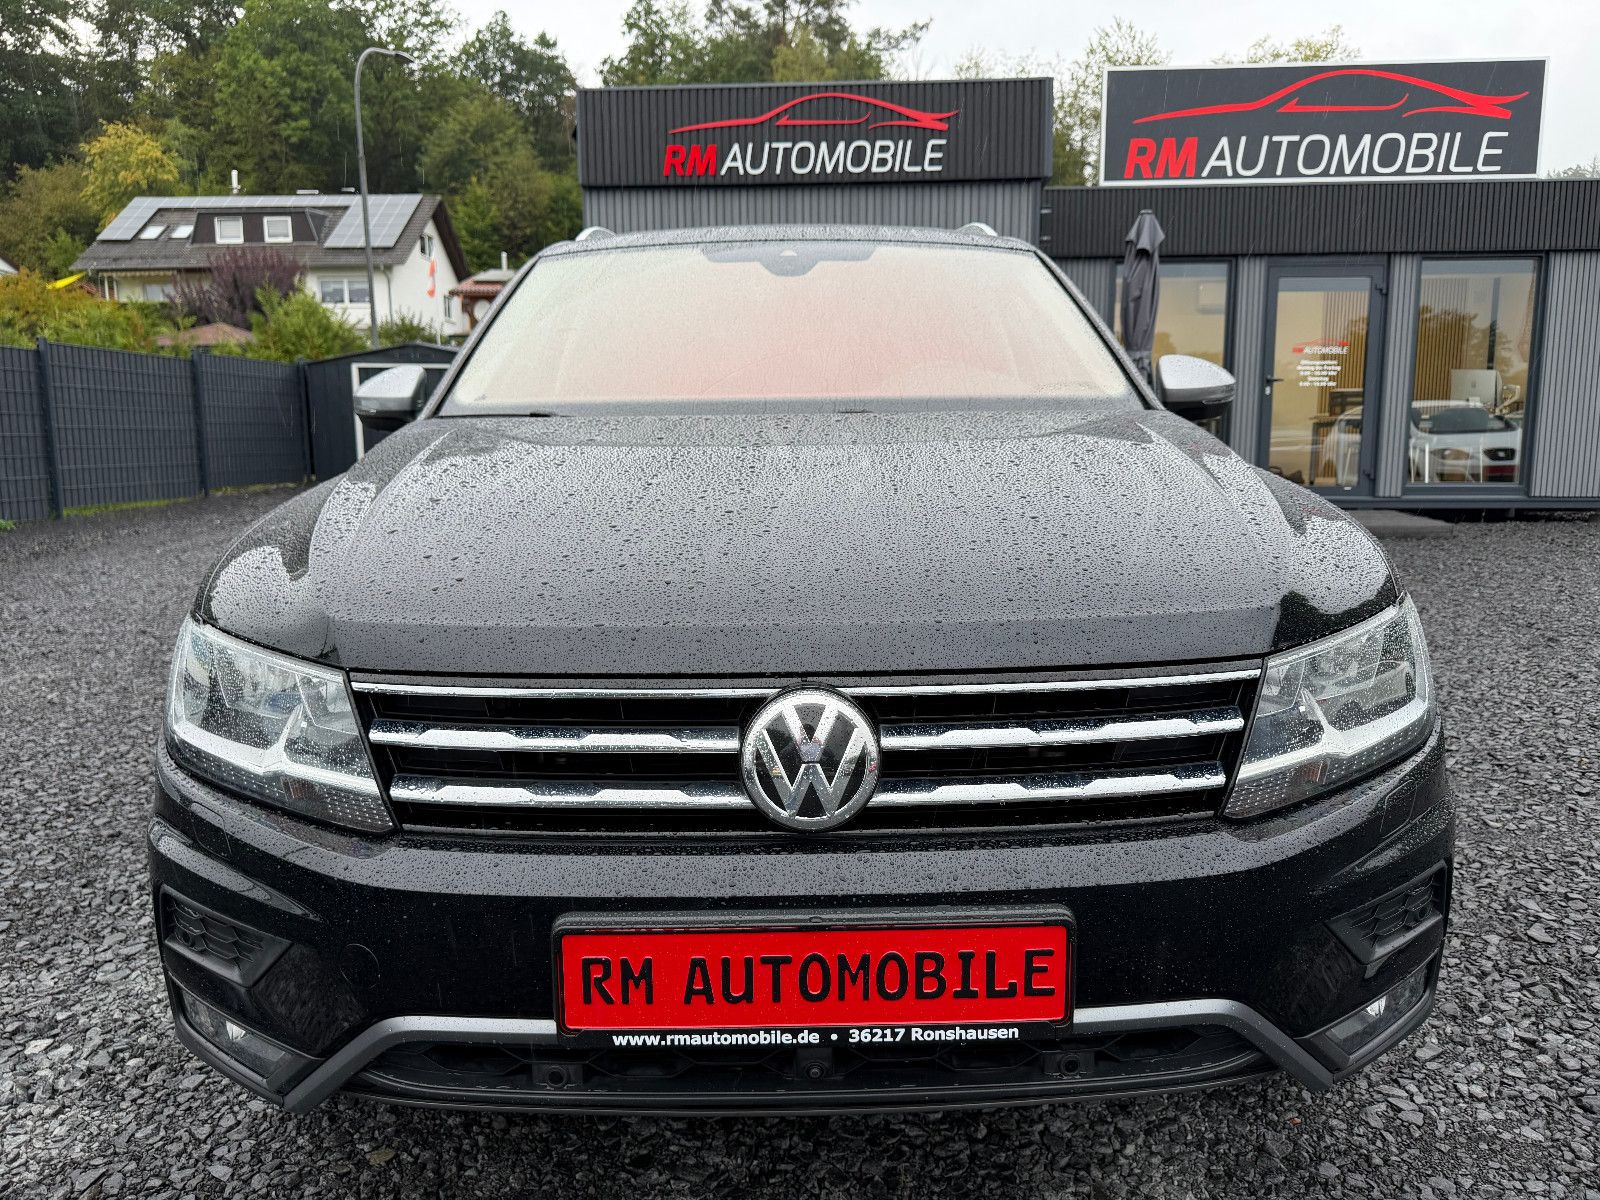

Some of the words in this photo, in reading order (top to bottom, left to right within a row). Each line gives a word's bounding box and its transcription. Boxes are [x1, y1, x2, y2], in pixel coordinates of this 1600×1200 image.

[663, 143, 718, 177] RM
[719, 138, 948, 176] AUTOMOBILE
[1123, 136, 1199, 179] RM
[1201, 130, 1509, 178] AUTOMOBILE
[1304, 346, 1349, 354] AUTOMOBILE
[580, 956, 654, 1005] RM
[683, 948, 1056, 1005] AUTOMOBILE
[612, 1031, 820, 1046] www.rmautomobile.de
[847, 1028, 906, 1043] 36217
[910, 1026, 1020, 1043] Ronshausen
